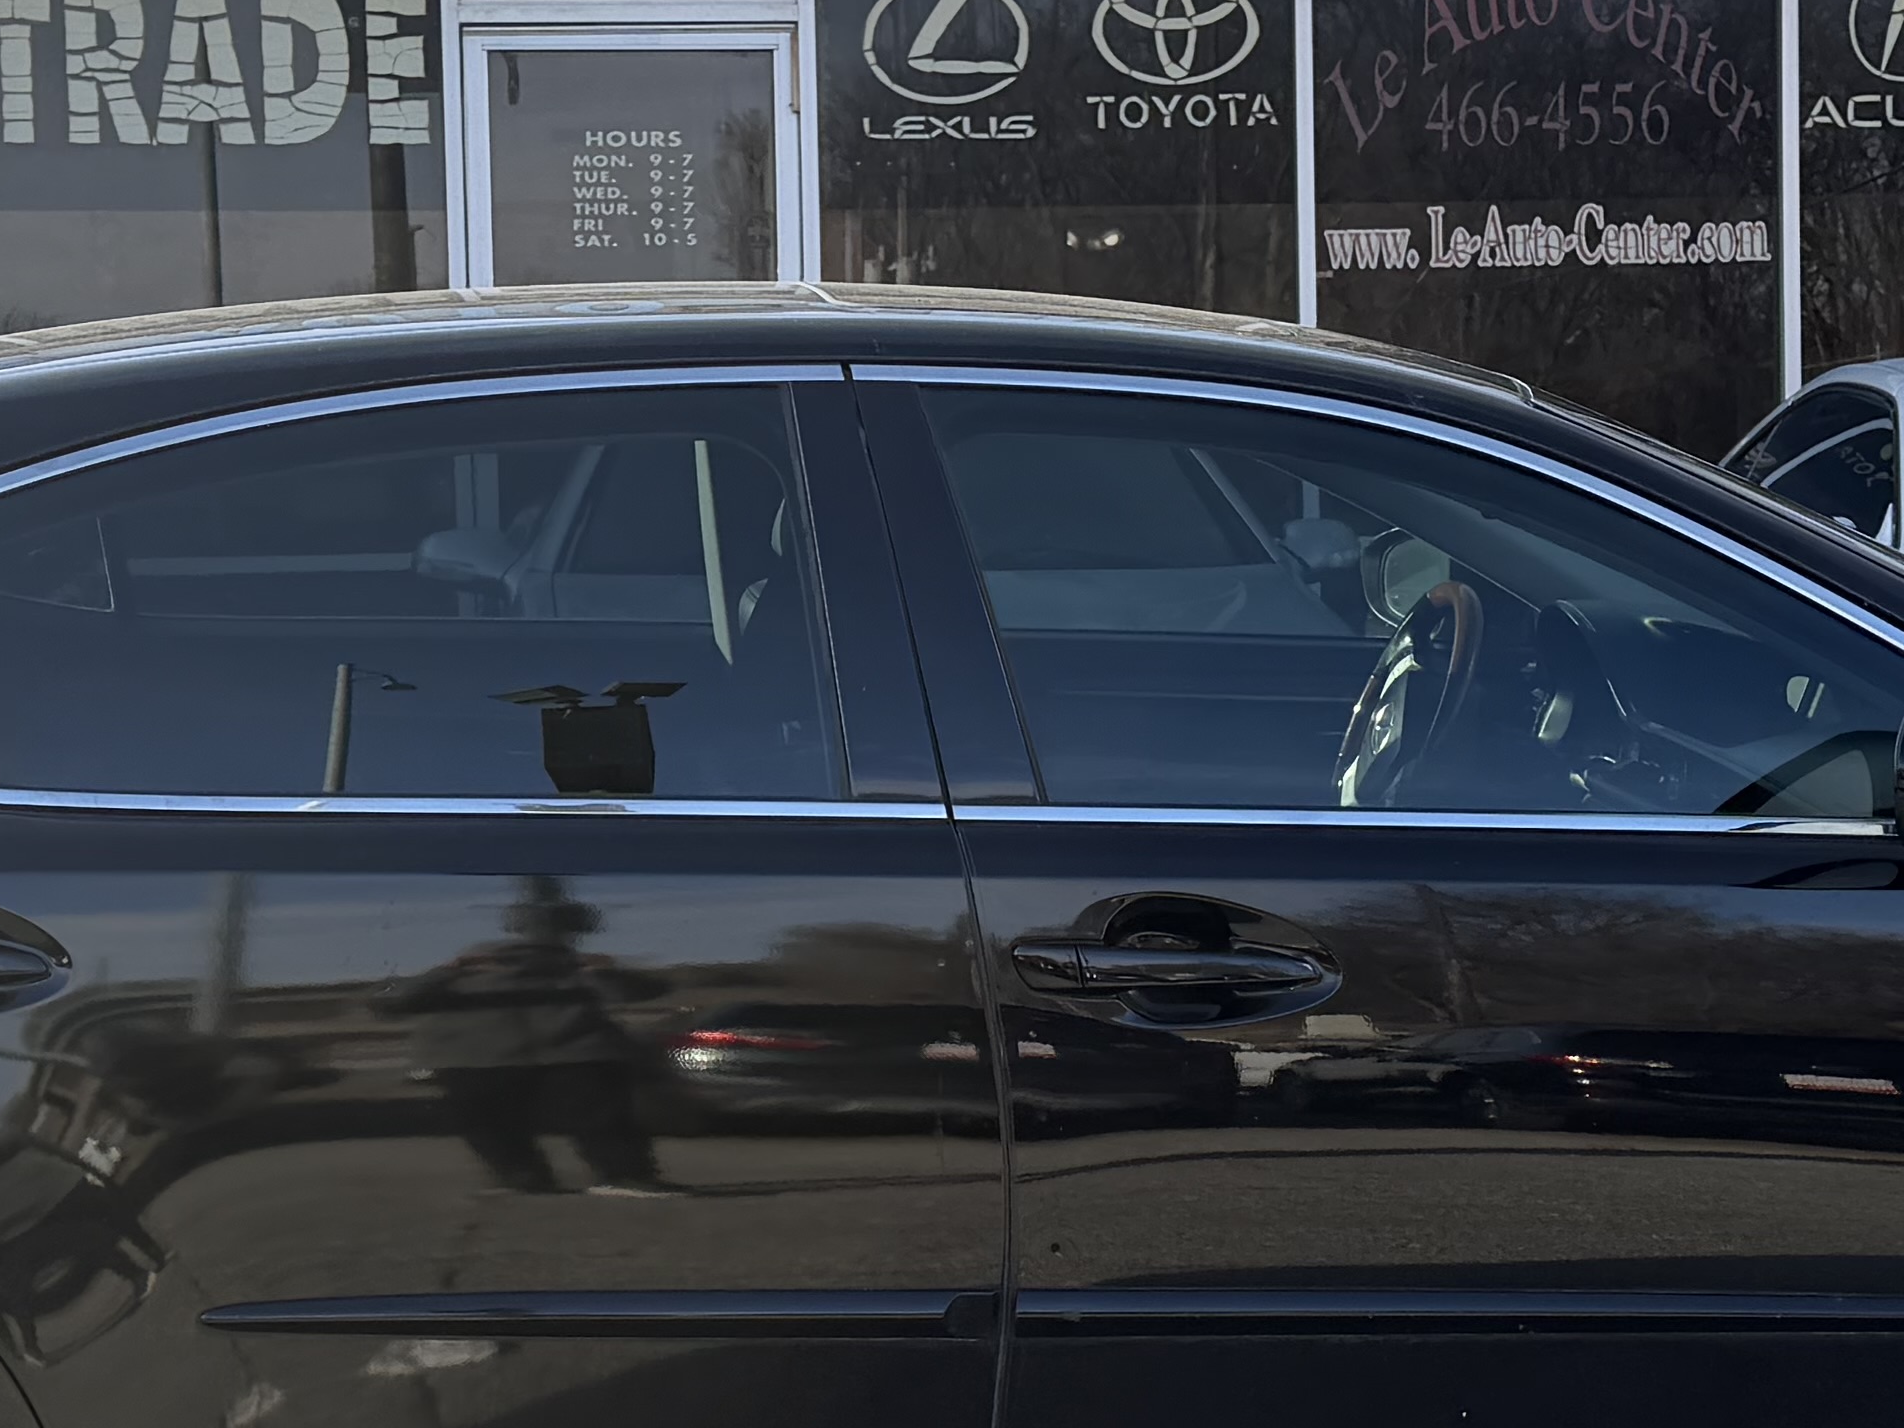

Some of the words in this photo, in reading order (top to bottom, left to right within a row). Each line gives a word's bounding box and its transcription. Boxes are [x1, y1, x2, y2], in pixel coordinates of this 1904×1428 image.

[1324, 49, 1407, 155] Le
[1086, 92, 1279, 130] TOYOTA
[1424, 79, 1670, 152] 466-4556
[862, 114, 1038, 140] LEXUS
[585, 130, 683, 148] HOURS
[572, 154, 634, 168] MON.
[572, 170, 617, 184] TUE.
[572, 186, 629, 200] WED.
[572, 202, 638, 216] THUR.
[572, 218, 604, 232] FRI
[574, 234, 619, 248] SAT.
